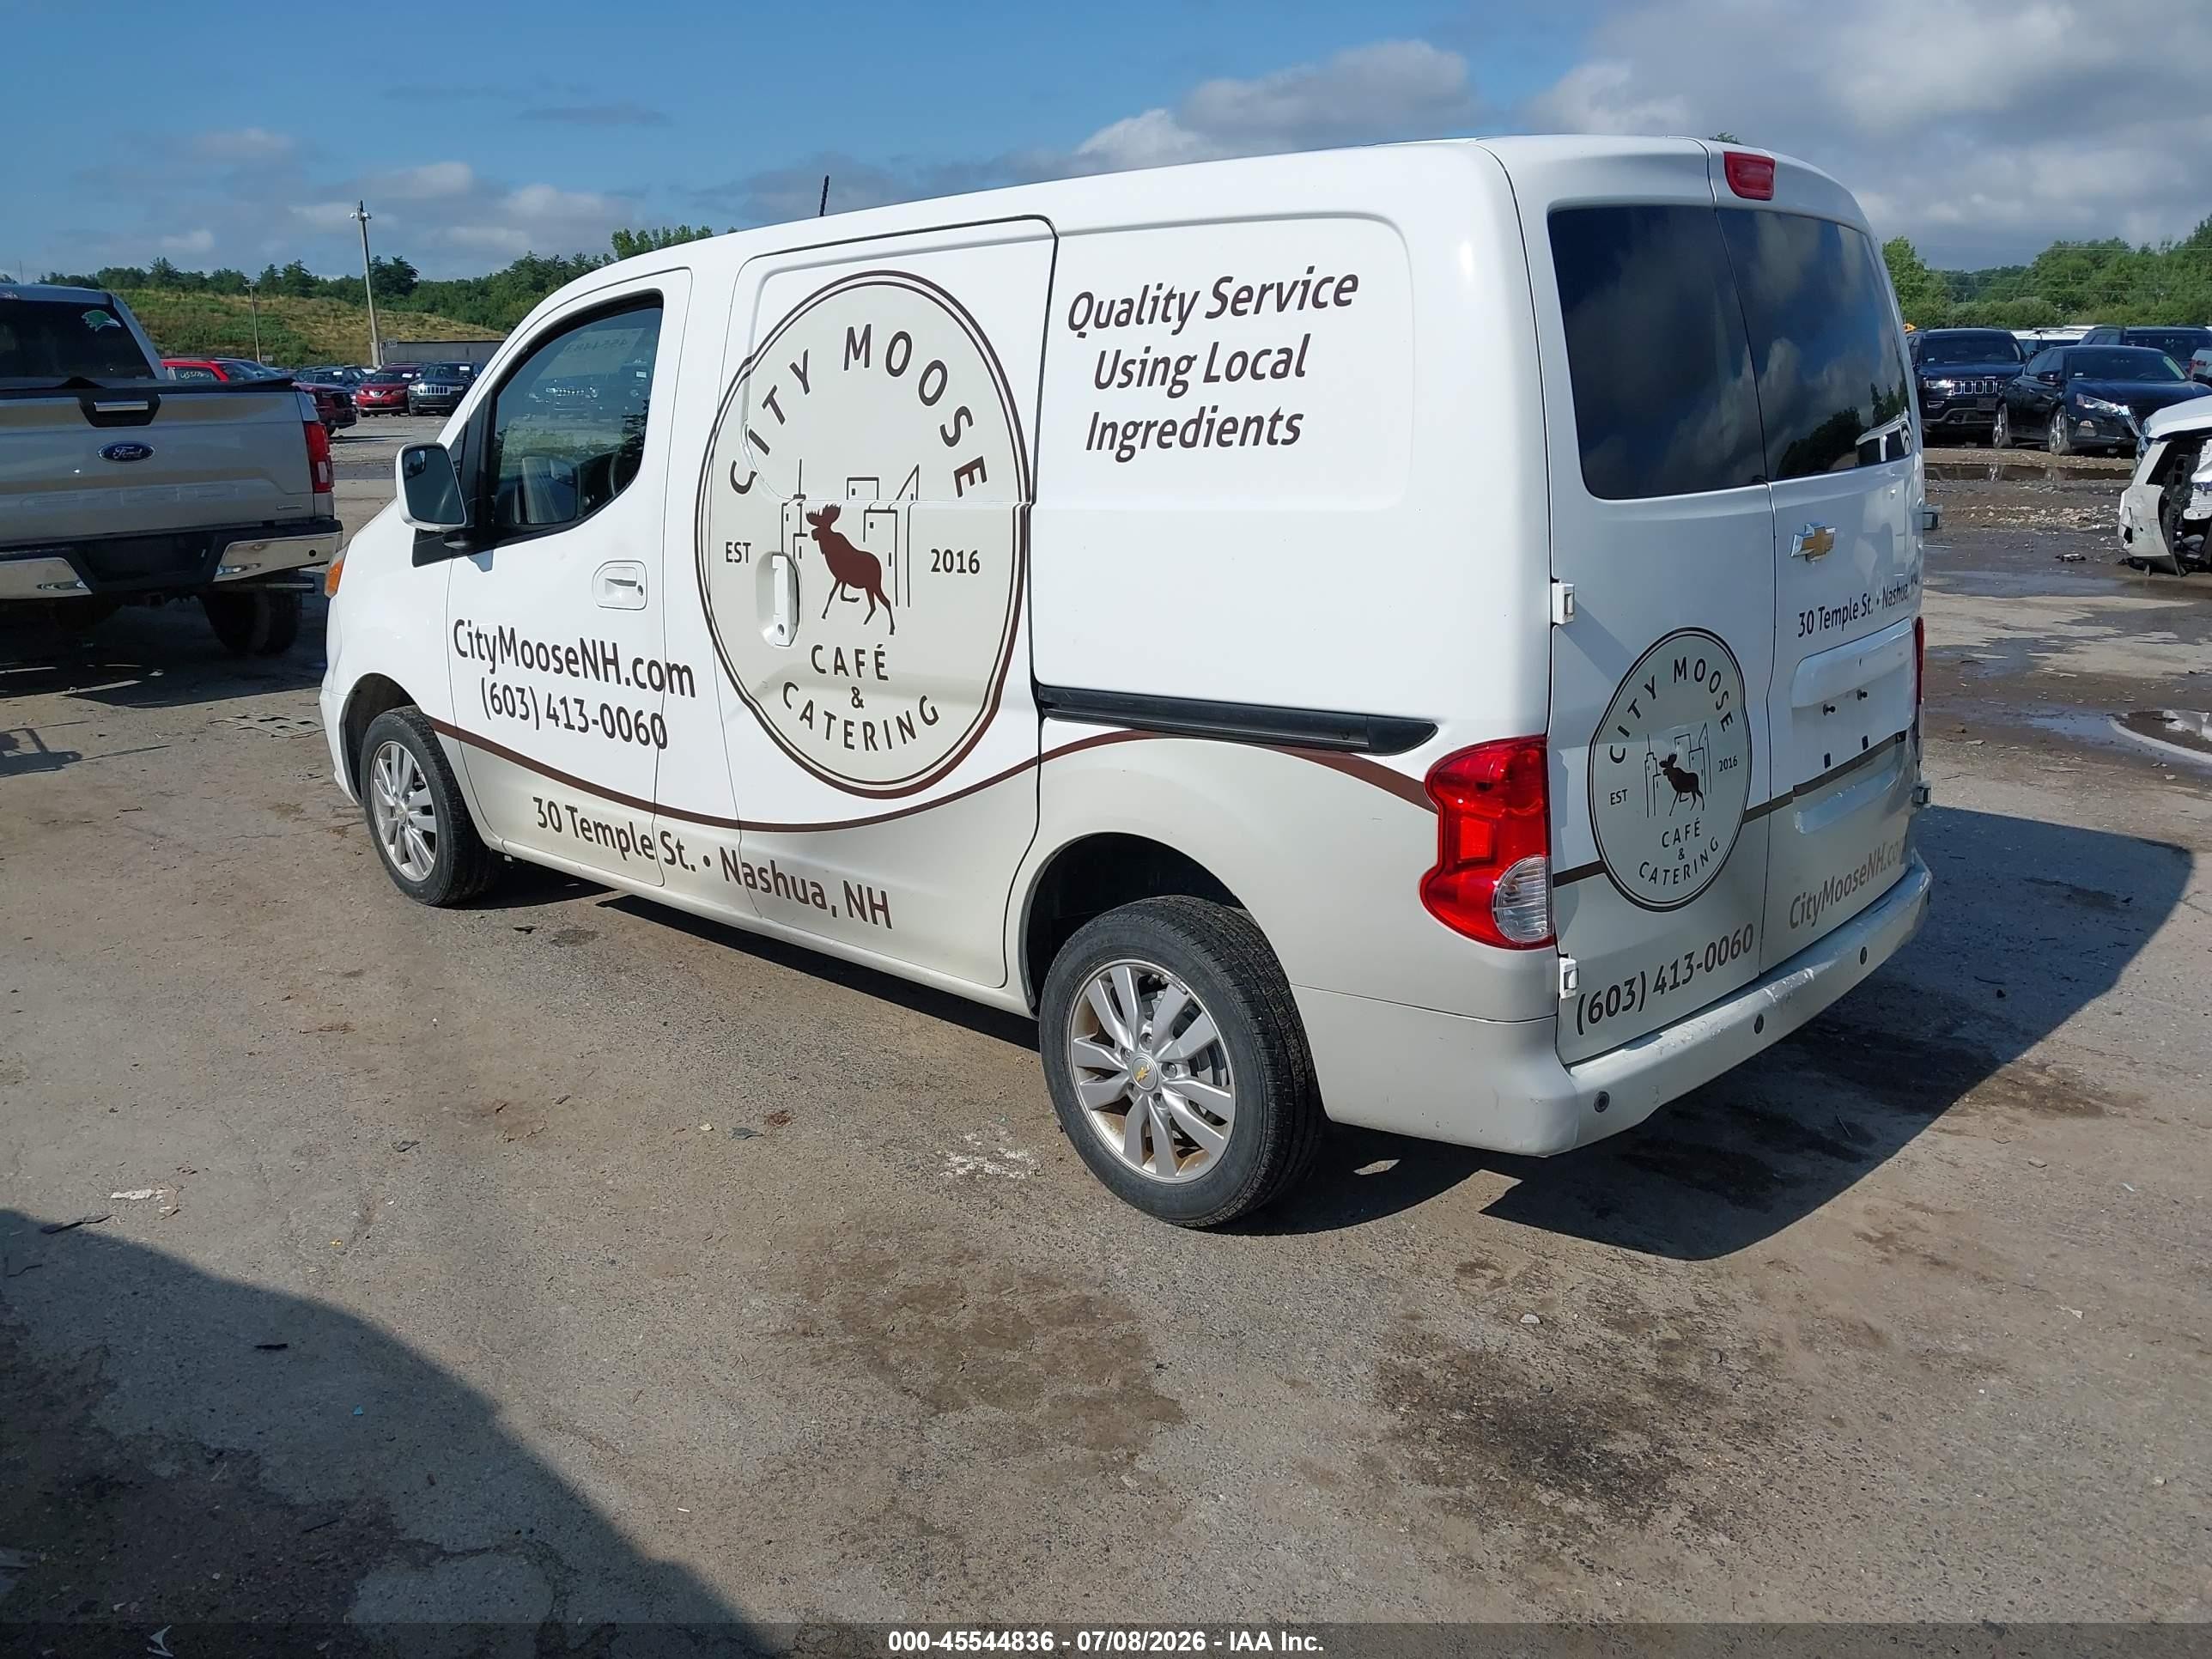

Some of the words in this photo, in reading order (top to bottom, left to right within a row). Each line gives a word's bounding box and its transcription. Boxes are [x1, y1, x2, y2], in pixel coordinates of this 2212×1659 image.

[1068, 283, 1200, 338] Quality
[1204, 265, 1359, 319] Service
[1094, 346, 1198, 398] Using
[1202, 333, 1311, 383] Local
[729, 348, 810, 495] CITY
[843, 324, 988, 497] MOOSE
[1085, 404, 1304, 463] Ingredients
[112, 446, 143, 460] Ford
[726, 542, 751, 563] EST
[930, 549, 981, 574] 2016
[1798, 609, 1815, 638] 30
[1818, 597, 1859, 631] Temple
[1862, 592, 1874, 617] St.
[453, 618, 696, 698] CityMooseNH.com
[811, 644, 889, 681] CAFÉ
[481, 677, 540, 731] (603)
[546, 692, 668, 750] 413-0060
[782, 682, 939, 751] CATERING
[851, 686, 865, 709] &
[1609, 675, 1656, 763] CITY
[1674, 656, 1734, 732] MOOSE
[1610, 789, 1628, 805] EST
[1718, 756, 1738, 772] 2016
[532, 796, 563, 834] 30
[565, 805, 655, 861] Temple
[660, 830, 696, 872] St.
[720, 846, 838, 918] Nashua,
[842, 879, 893, 930] NH
[1639, 836, 1719, 885] CATERING
[1662, 817, 1701, 848] CAFÉ
[1678, 848, 1686, 860] &
[1790, 839, 1905, 929] CityMooseNH.co
[1577, 971, 1646, 1036] (603)
[1653, 923, 1753, 994] 413-0060
